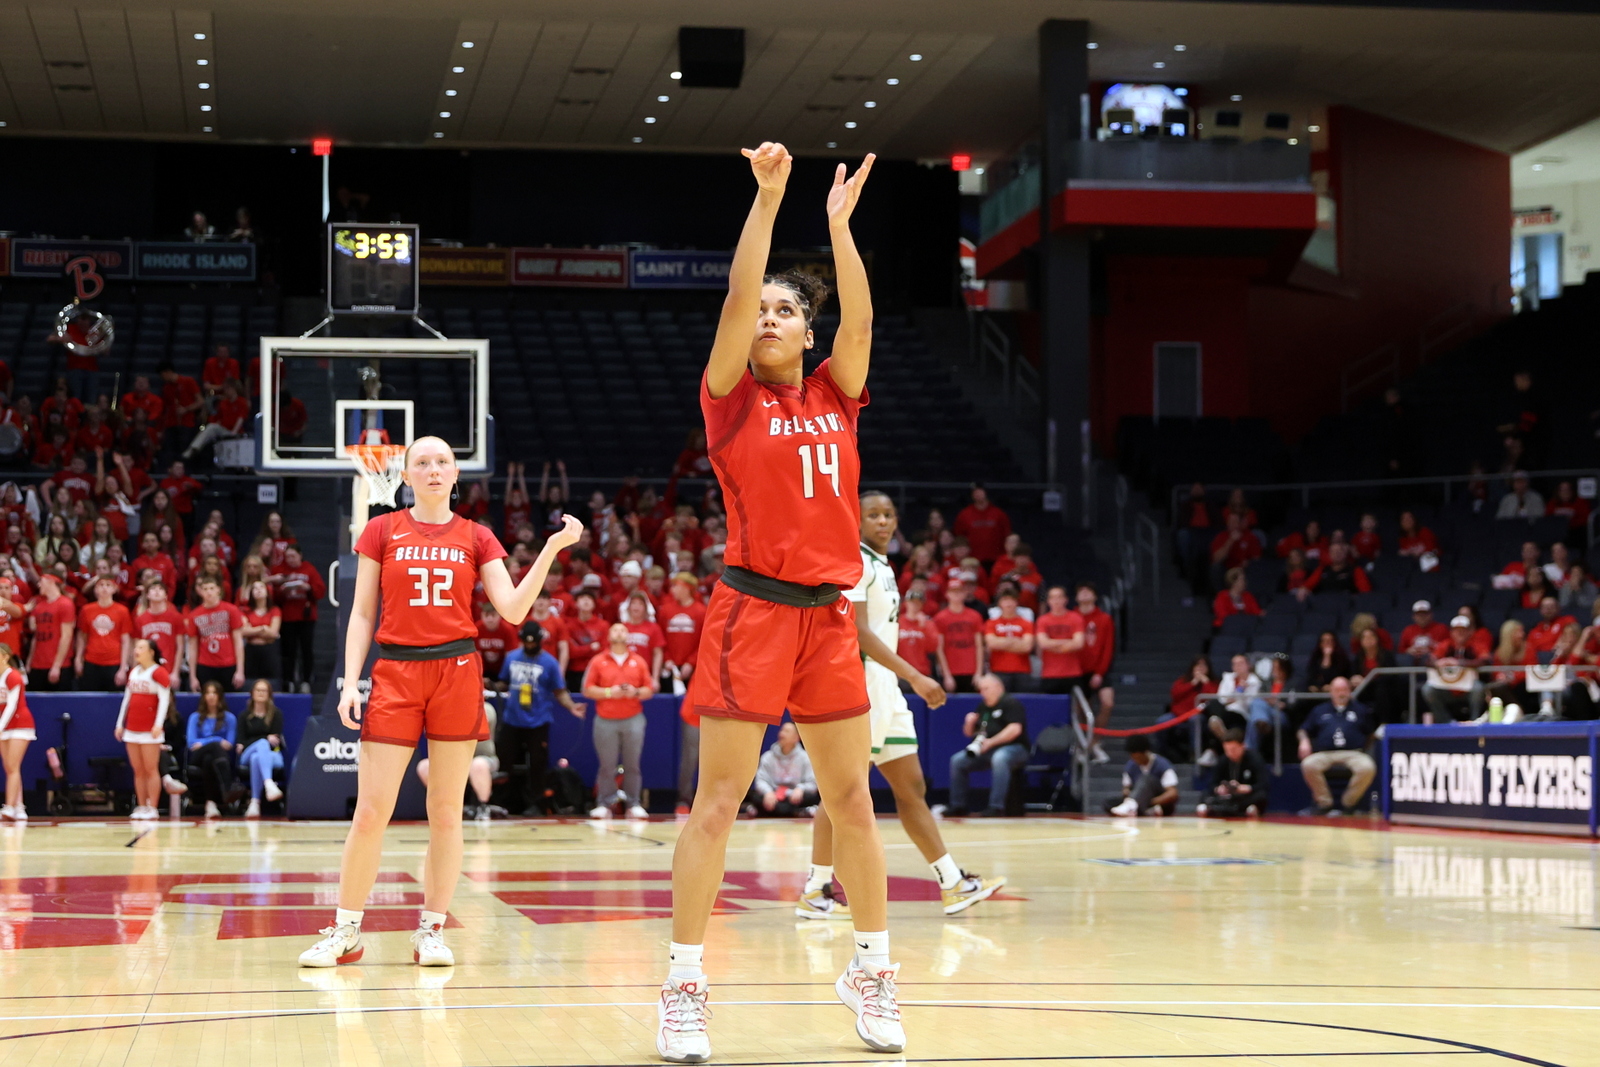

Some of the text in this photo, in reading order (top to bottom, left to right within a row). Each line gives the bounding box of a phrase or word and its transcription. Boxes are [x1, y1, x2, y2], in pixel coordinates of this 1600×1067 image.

[22, 249, 121, 268] RICHND
[355, 232, 409, 259] 3:53
[142, 253, 248, 269] RHODE ISLAND
[636, 261, 684, 277] SAINT
[65, 256, 104, 300] B
[798, 443, 840, 498] 14
[395, 546, 466, 564] BELLEVUE
[407, 567, 454, 607] 32
[1391, 752, 1592, 810] DAYTON FLYERS
